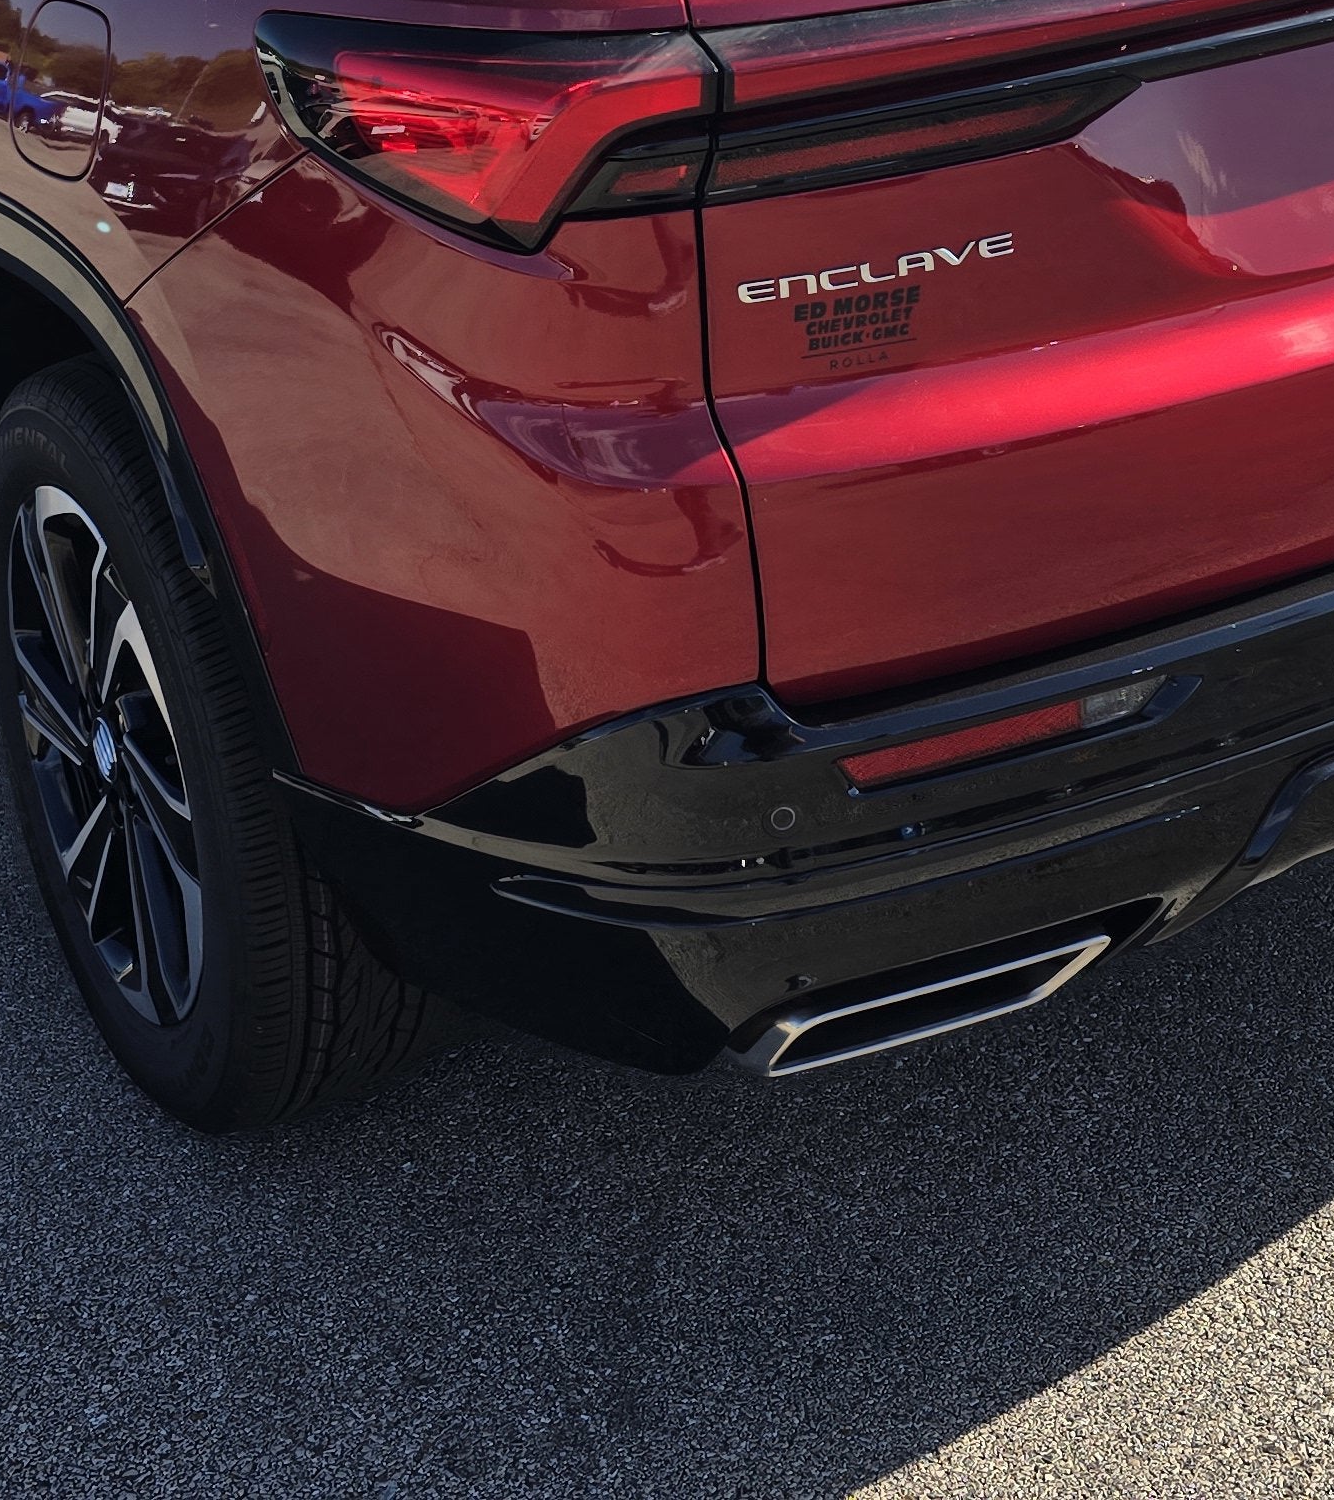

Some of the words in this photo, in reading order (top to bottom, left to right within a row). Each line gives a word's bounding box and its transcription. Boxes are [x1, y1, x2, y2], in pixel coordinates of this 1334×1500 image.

[737, 232, 1015, 304] ENCLAVE
[794, 300, 826, 322] ED
[833, 285, 922, 316] MORSE
[805, 307, 913, 336] CHEVROLET
[829, 351, 890, 371] ROLLA
